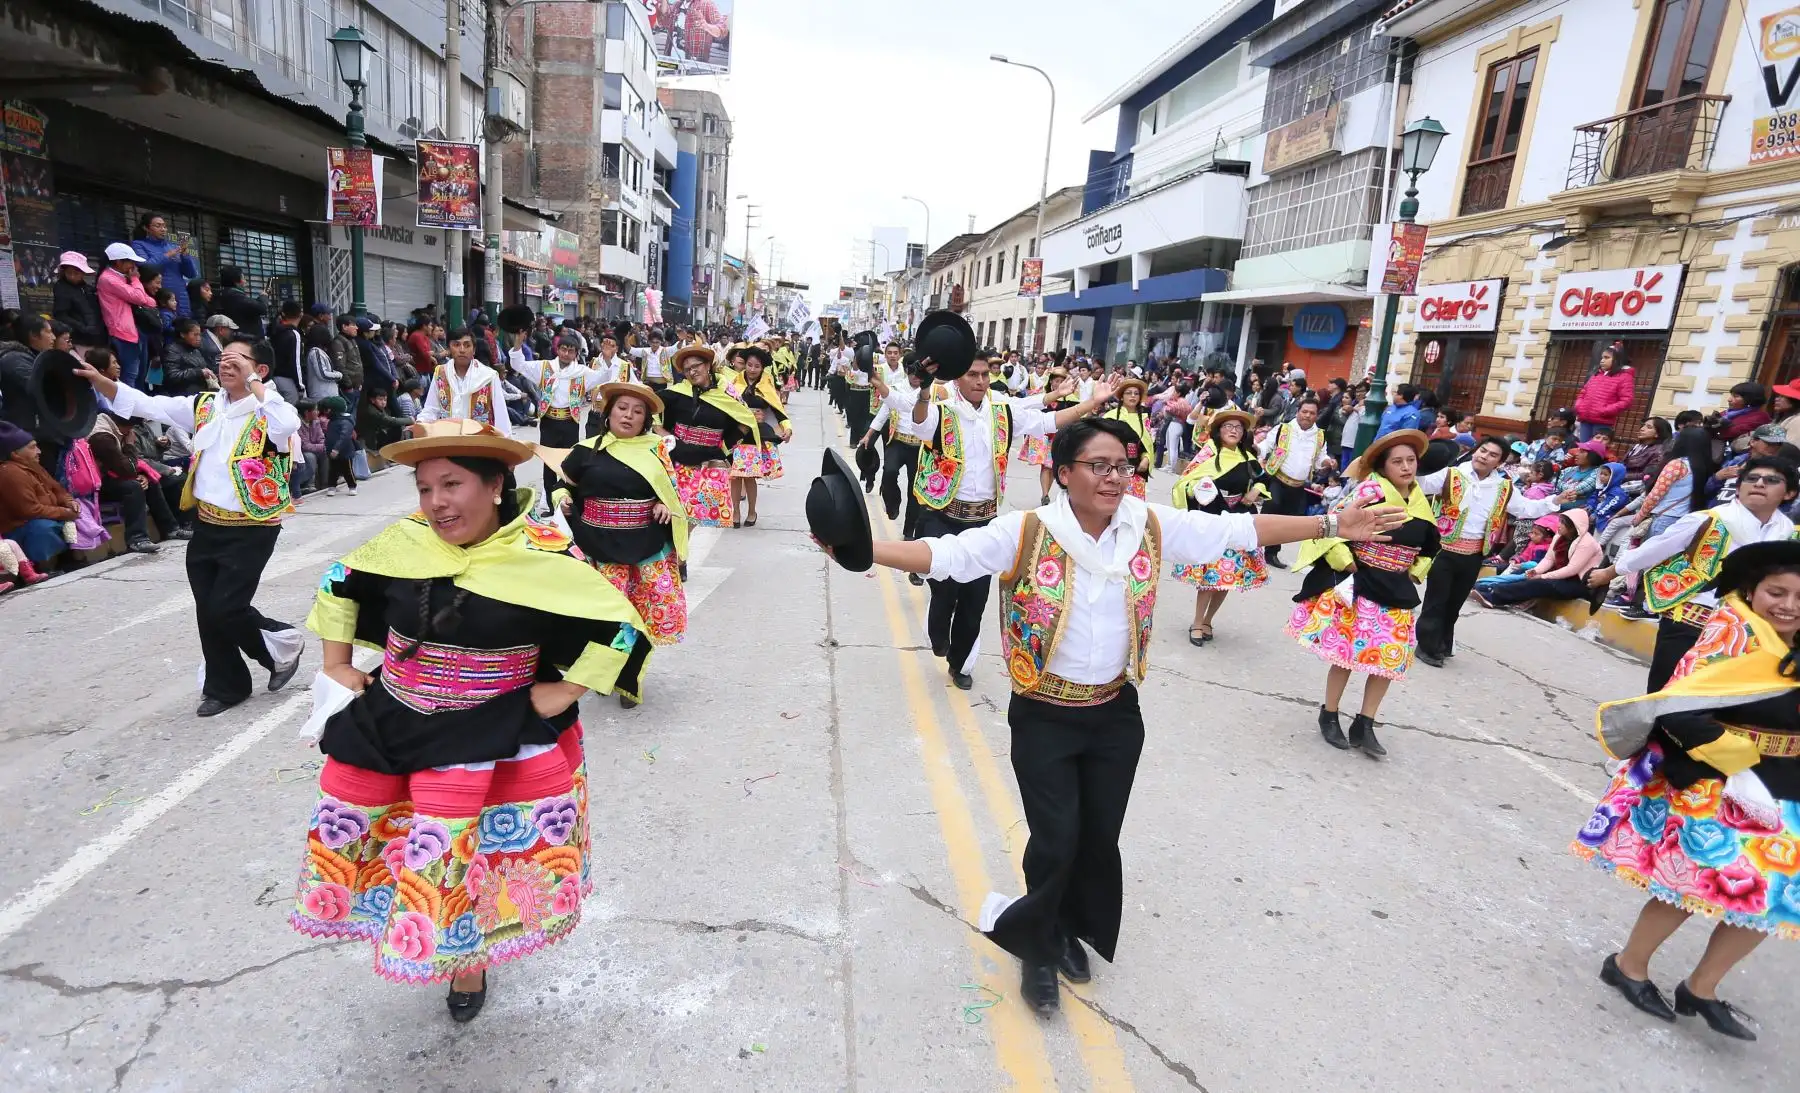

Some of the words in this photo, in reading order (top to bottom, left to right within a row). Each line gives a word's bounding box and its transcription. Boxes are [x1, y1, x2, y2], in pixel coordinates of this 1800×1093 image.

[1087, 223, 1122, 249] confianza
[1420, 296, 1478, 321] Claro
[1559, 286, 1646, 317] Claro
[1561, 320, 1603, 328] DISTRIBUIDOR
